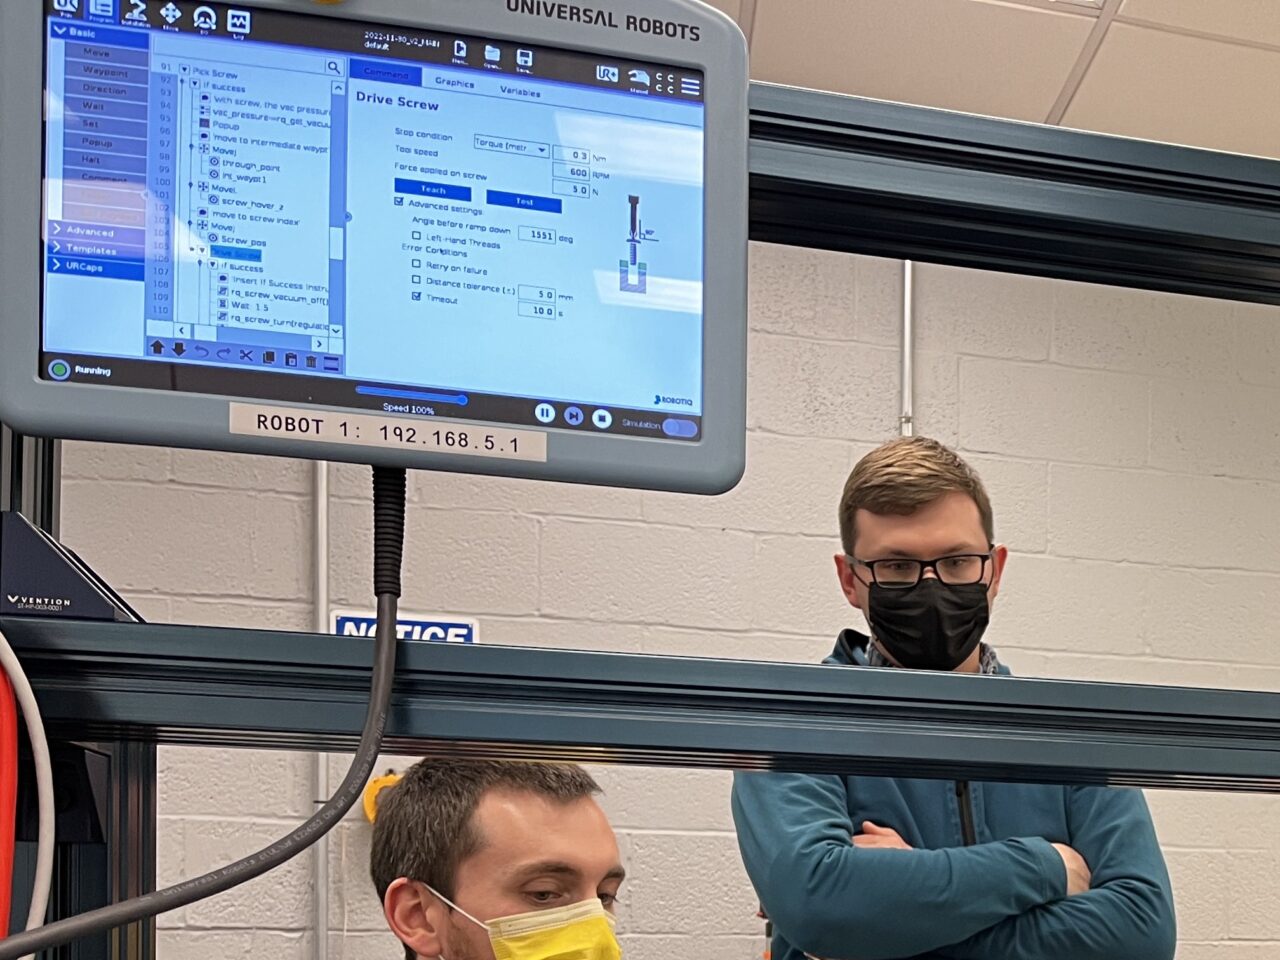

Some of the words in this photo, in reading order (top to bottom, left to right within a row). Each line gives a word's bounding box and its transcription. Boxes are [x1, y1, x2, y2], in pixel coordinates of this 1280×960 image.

[507, 0, 618, 29] UNIVERSAL
[626, 15, 701, 42] ROBOTS
[69, 27, 96, 39] Basic
[83, 47, 110, 57] Move
[82, 65, 128, 79] Waypoint
[212, 69, 238, 80] Screw
[364, 67, 409, 80] Command
[212, 83, 246, 94] success
[435, 76, 475, 89] Graphics
[82, 83, 127, 95] Direction
[500, 86, 541, 98] Variables
[82, 101, 104, 111] Wait
[265, 100, 278, 110] the
[356, 91, 393, 106] Drive
[397, 97, 439, 111] Screw
[82, 119, 99, 128] Set
[213, 119, 240, 131] Popup
[395, 127, 414, 138] Stop
[416, 130, 453, 142] condition
[82, 137, 113, 149] Popup
[251, 138, 301, 151] intermediate
[476, 137, 503, 150] Torque
[396, 144, 412, 155] Tool
[413, 147, 439, 159] speed
[82, 154, 101, 164] Halt
[81, 172, 127, 183] Comment
[394, 162, 418, 173] Force
[420, 165, 448, 177] applied
[463, 172, 488, 182] screw
[570, 167, 587, 177] 600
[592, 171, 610, 181] RPM
[421, 184, 446, 196] Teach
[573, 184, 587, 195] 5.0
[408, 199, 449, 212] Advanced
[451, 204, 483, 217] settings
[516, 197, 534, 207] Test
[250, 214, 274, 224] screw
[412, 215, 435, 228] Angle
[437, 218, 463, 230] before
[466, 223, 487, 234] ramp
[489, 224, 511, 235] down
[67, 225, 115, 238] Advanced
[469, 239, 501, 251] Threads
[558, 234, 574, 245] deg
[66, 243, 117, 257] Templates
[401, 242, 423, 253] Error
[426, 245, 468, 258] Conditions
[66, 261, 104, 273] URCaps
[230, 263, 264, 273] success
[426, 261, 449, 273] Retry
[451, 265, 461, 273] on
[464, 265, 488, 276] failure
[426, 277, 461, 289] Distance
[463, 281, 500, 294] tolerance
[427, 293, 458, 305] Timeout
[558, 293, 574, 301] mm
[75, 364, 112, 377] Running
[662, 395, 693, 407] ROBOTIQ
[383, 402, 409, 415] Speed
[412, 403, 435, 416] 100%
[622, 417, 662, 431] Simulation
[257, 414, 324, 435] ROBOT
[339, 421, 361, 439] 1:
[380, 425, 519, 453] 192.168.5.1
[21, 596, 71, 606] VENTION
